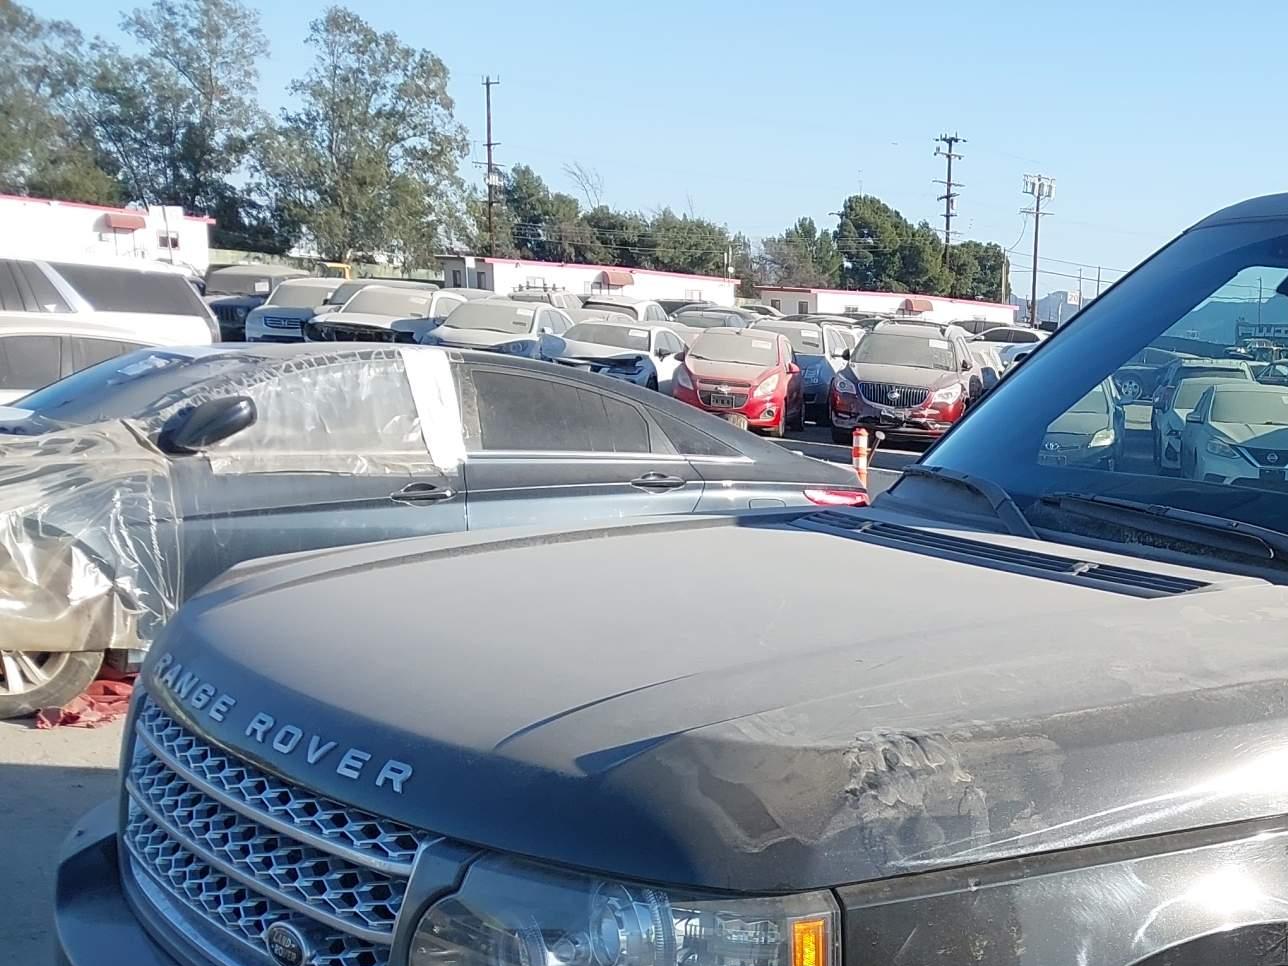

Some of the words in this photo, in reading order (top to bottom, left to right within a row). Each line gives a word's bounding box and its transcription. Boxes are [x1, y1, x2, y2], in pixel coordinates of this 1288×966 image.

[153, 652, 237, 724] RANGE
[245, 711, 414, 794] ROVER
[273, 943, 298, 963] ROVER
